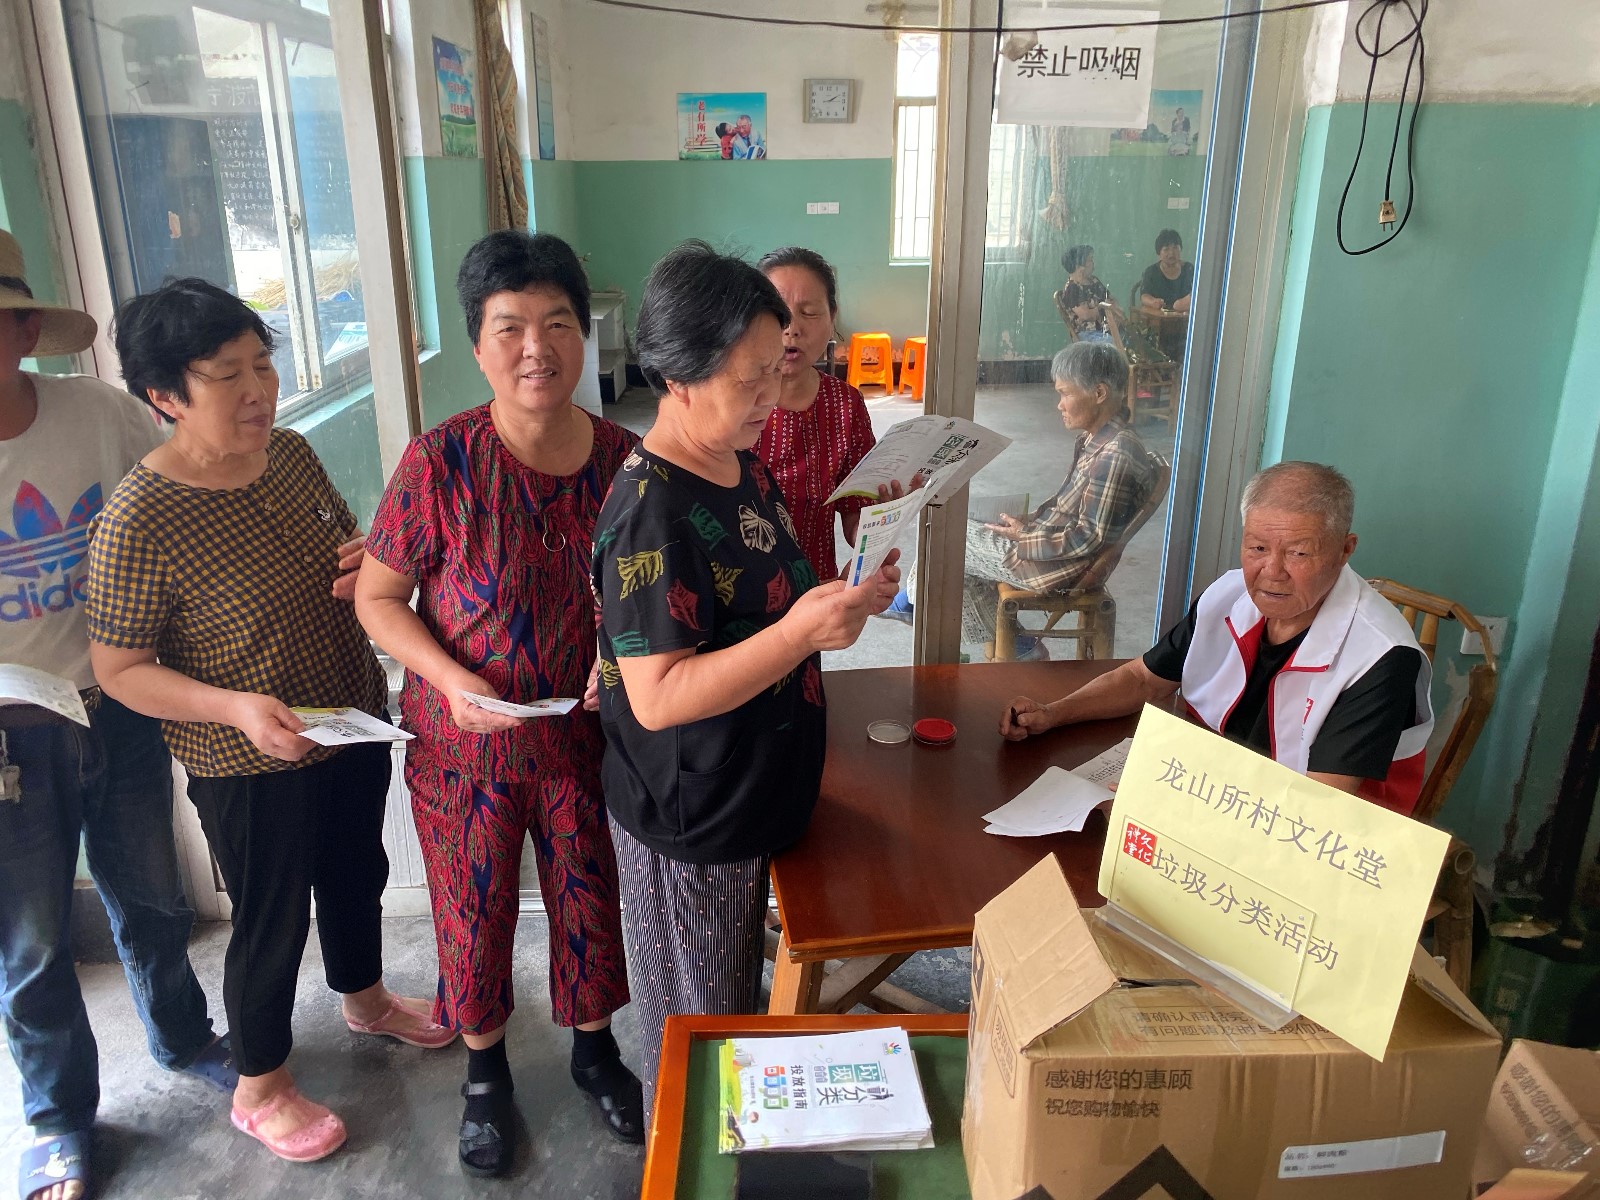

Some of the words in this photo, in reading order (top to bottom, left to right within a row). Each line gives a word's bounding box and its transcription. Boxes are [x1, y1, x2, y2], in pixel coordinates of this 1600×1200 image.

[1017, 44, 1142, 81] 禁止吸烟
[1155, 756, 1388, 890] 龙山所村文化堂
[1151, 847, 1340, 971] 垃圾分类活动
[1132, 1010, 1252, 1023] 请确认商品完
[790, 1064, 809, 1110] 投放指南
[1045, 1068, 1193, 1090] 感谢您的惠顾
[1045, 1097, 1160, 1118] 祝您购物愉快
